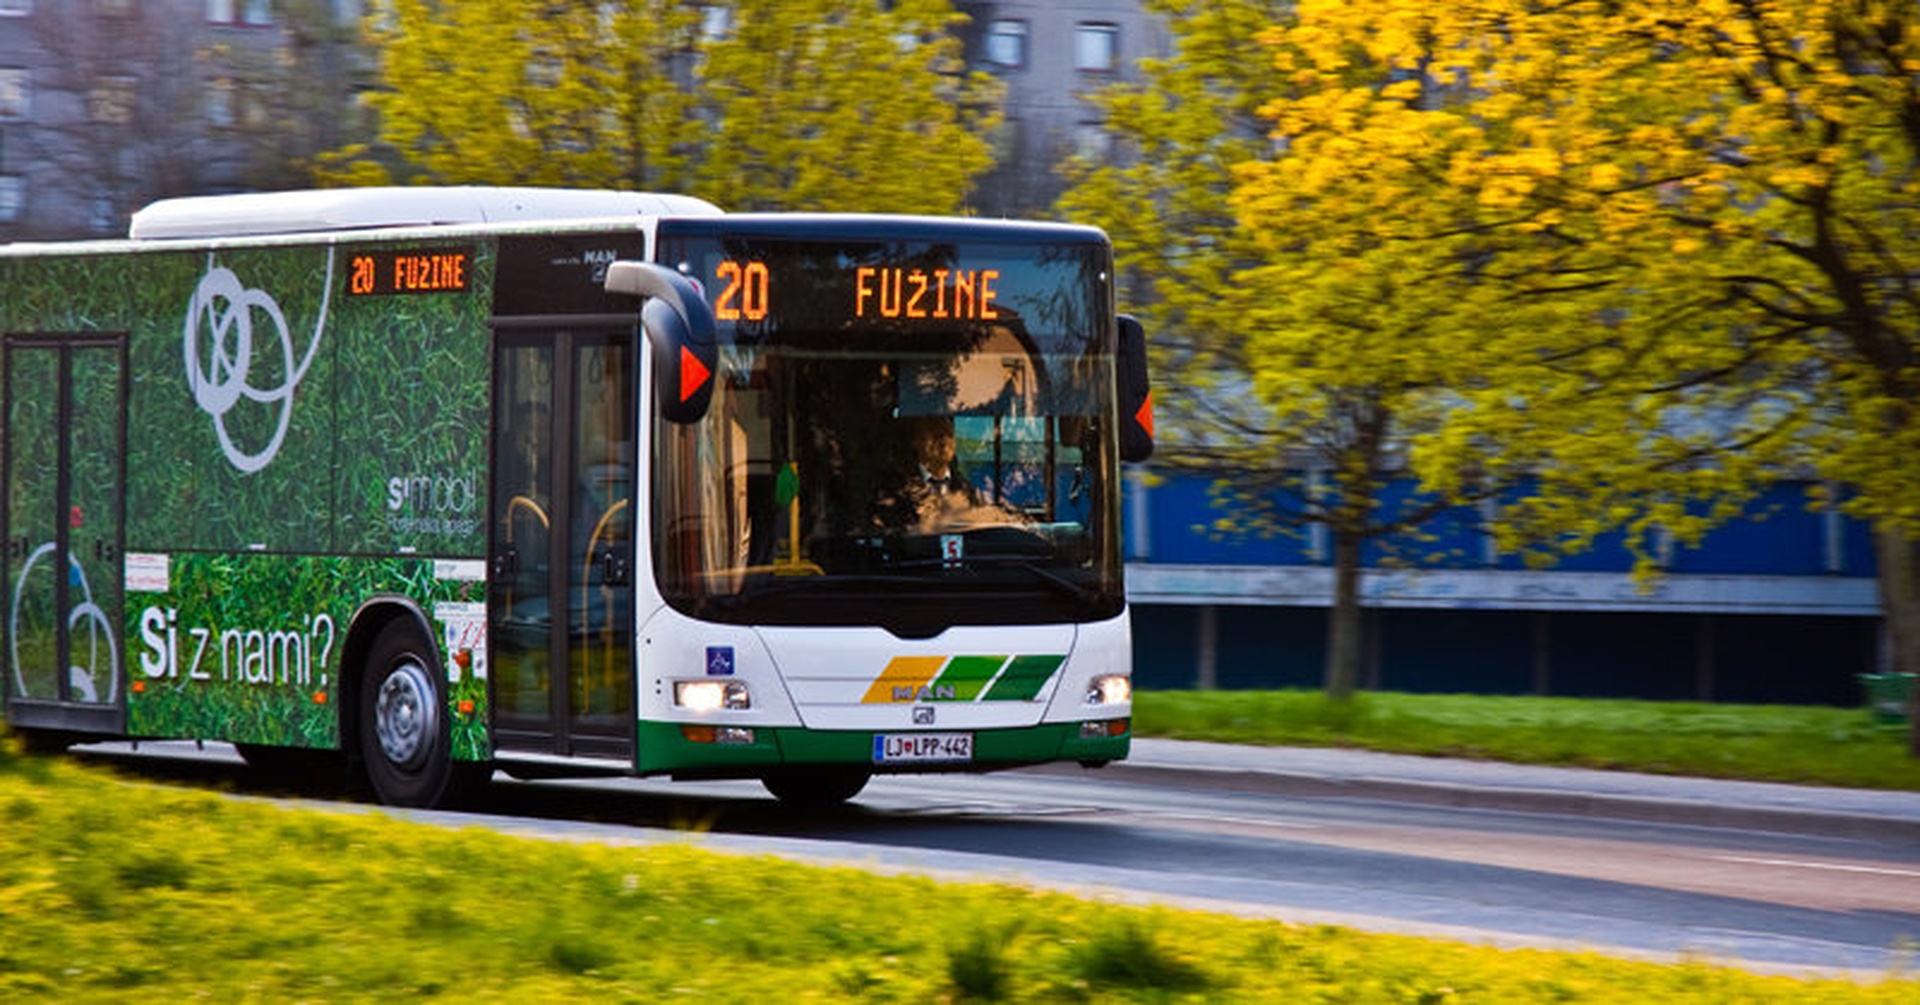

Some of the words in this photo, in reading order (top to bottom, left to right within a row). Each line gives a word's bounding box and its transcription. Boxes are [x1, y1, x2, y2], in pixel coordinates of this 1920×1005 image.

[352, 256, 375, 294] 20
[715, 260, 770, 321] 20
[140, 604, 178, 680] Si
[188, 627, 212, 680] z
[220, 612, 335, 686] nami?
[892, 685, 956, 700] MAN
[913, 737, 970, 757] LPP-442
